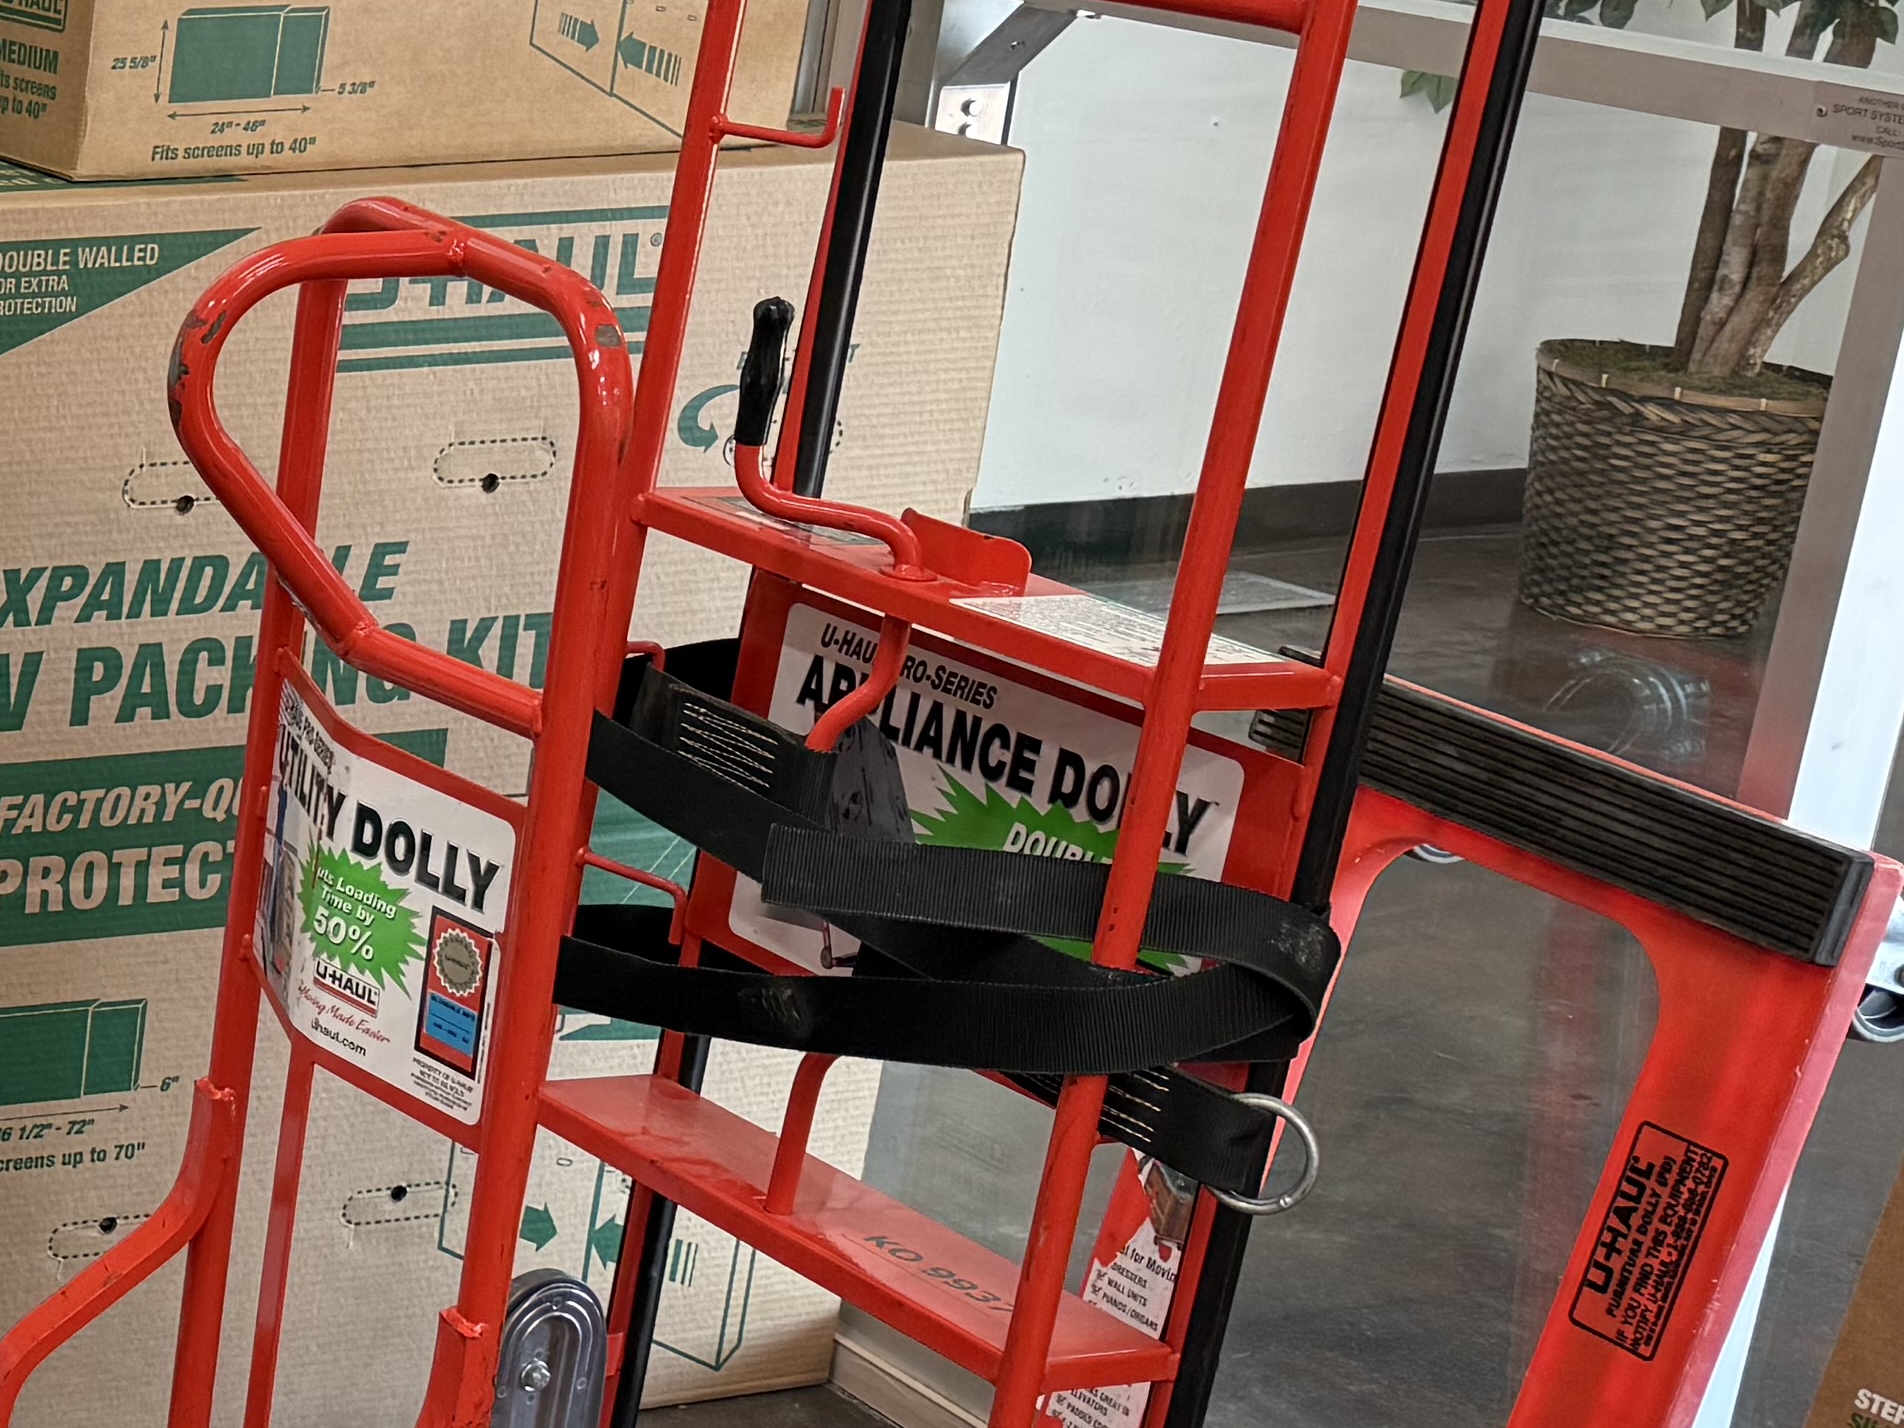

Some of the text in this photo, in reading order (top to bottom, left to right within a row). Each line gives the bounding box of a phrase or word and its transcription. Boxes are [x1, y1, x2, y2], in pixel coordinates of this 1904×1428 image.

[78, 243, 159, 270] WALLED
[20, 275, 69, 294] EXTRA
[351, 799, 502, 914] DOLLY
[336, 878, 397, 920] Loading
[313, 904, 375, 961] 50%
[62, 1151, 84, 1169] up
[90, 1147, 106, 1163] to
